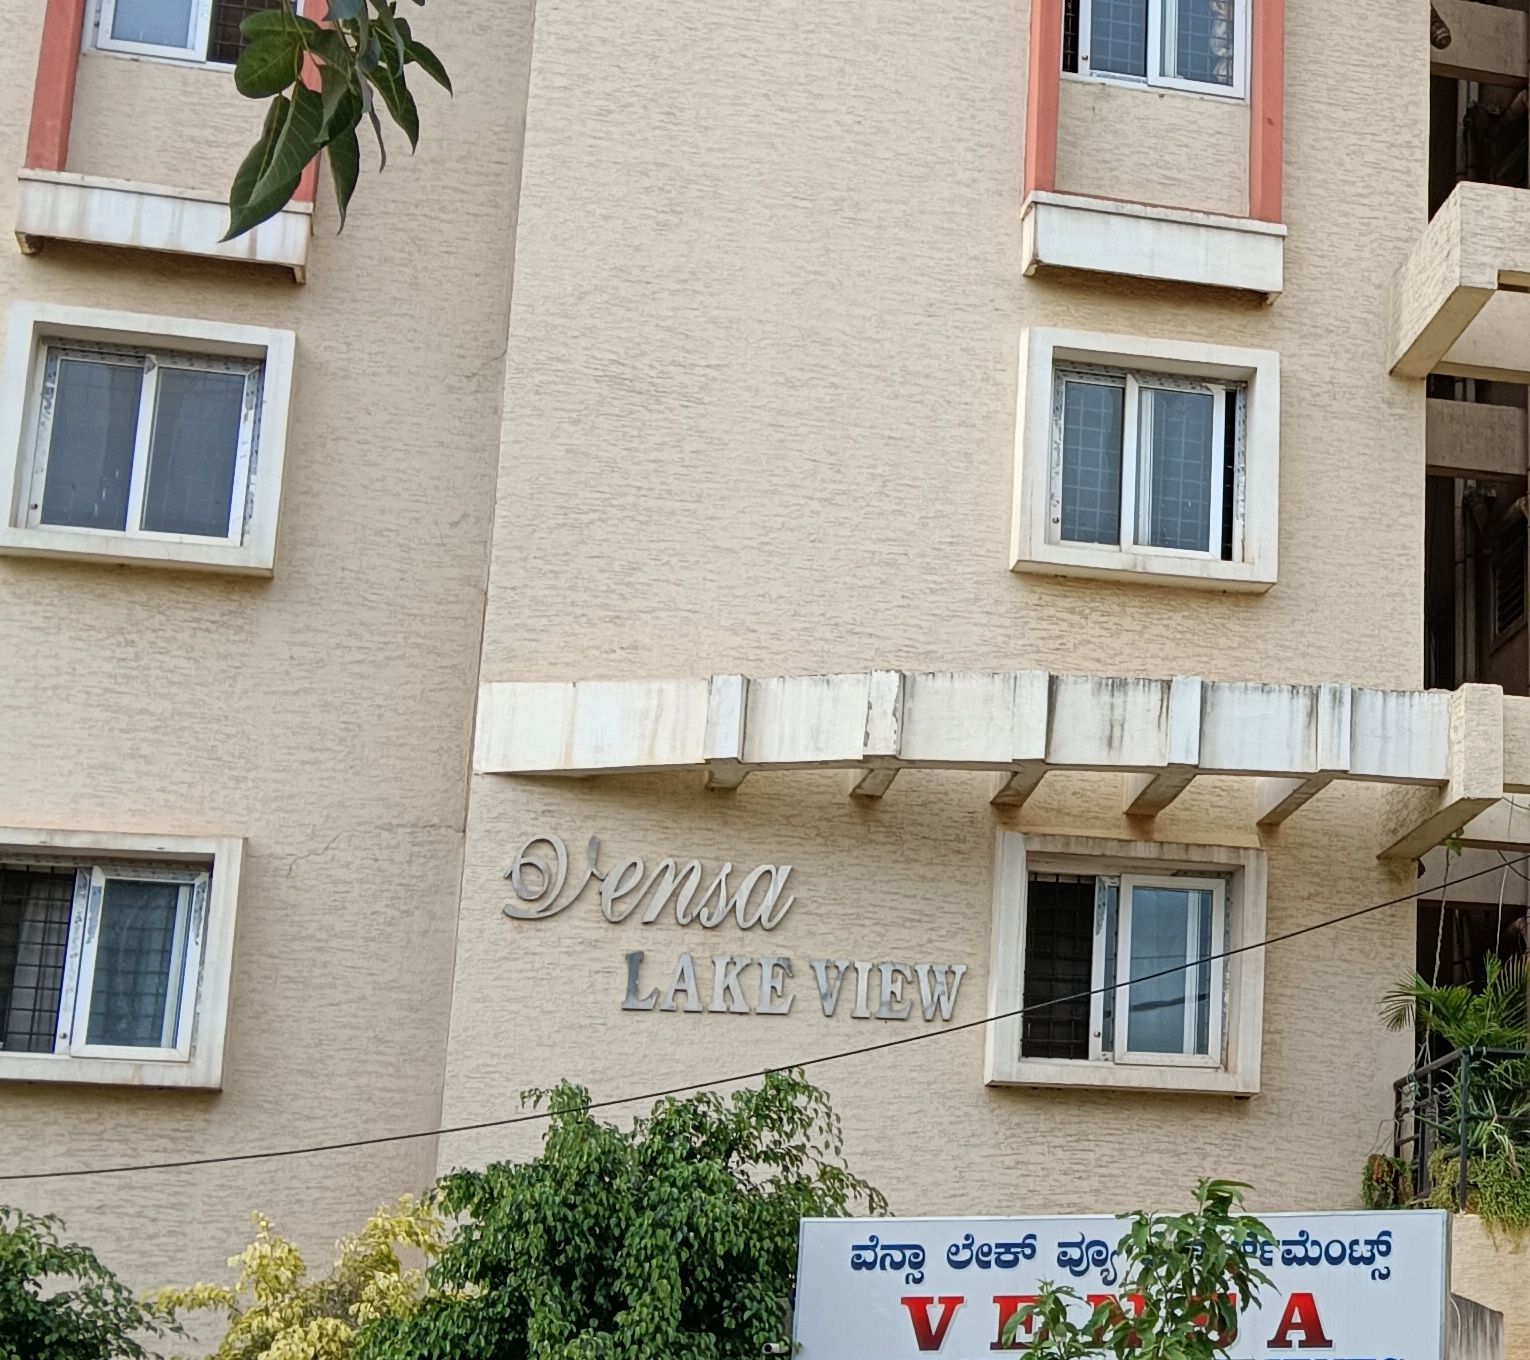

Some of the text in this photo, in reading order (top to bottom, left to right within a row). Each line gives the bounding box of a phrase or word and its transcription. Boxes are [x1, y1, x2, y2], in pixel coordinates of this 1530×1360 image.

[504, 833, 795, 931] Vensa
[621, 950, 967, 1021] LAKE VIEW
[947, 1232, 1037, 1270] ಲೇಕ್
